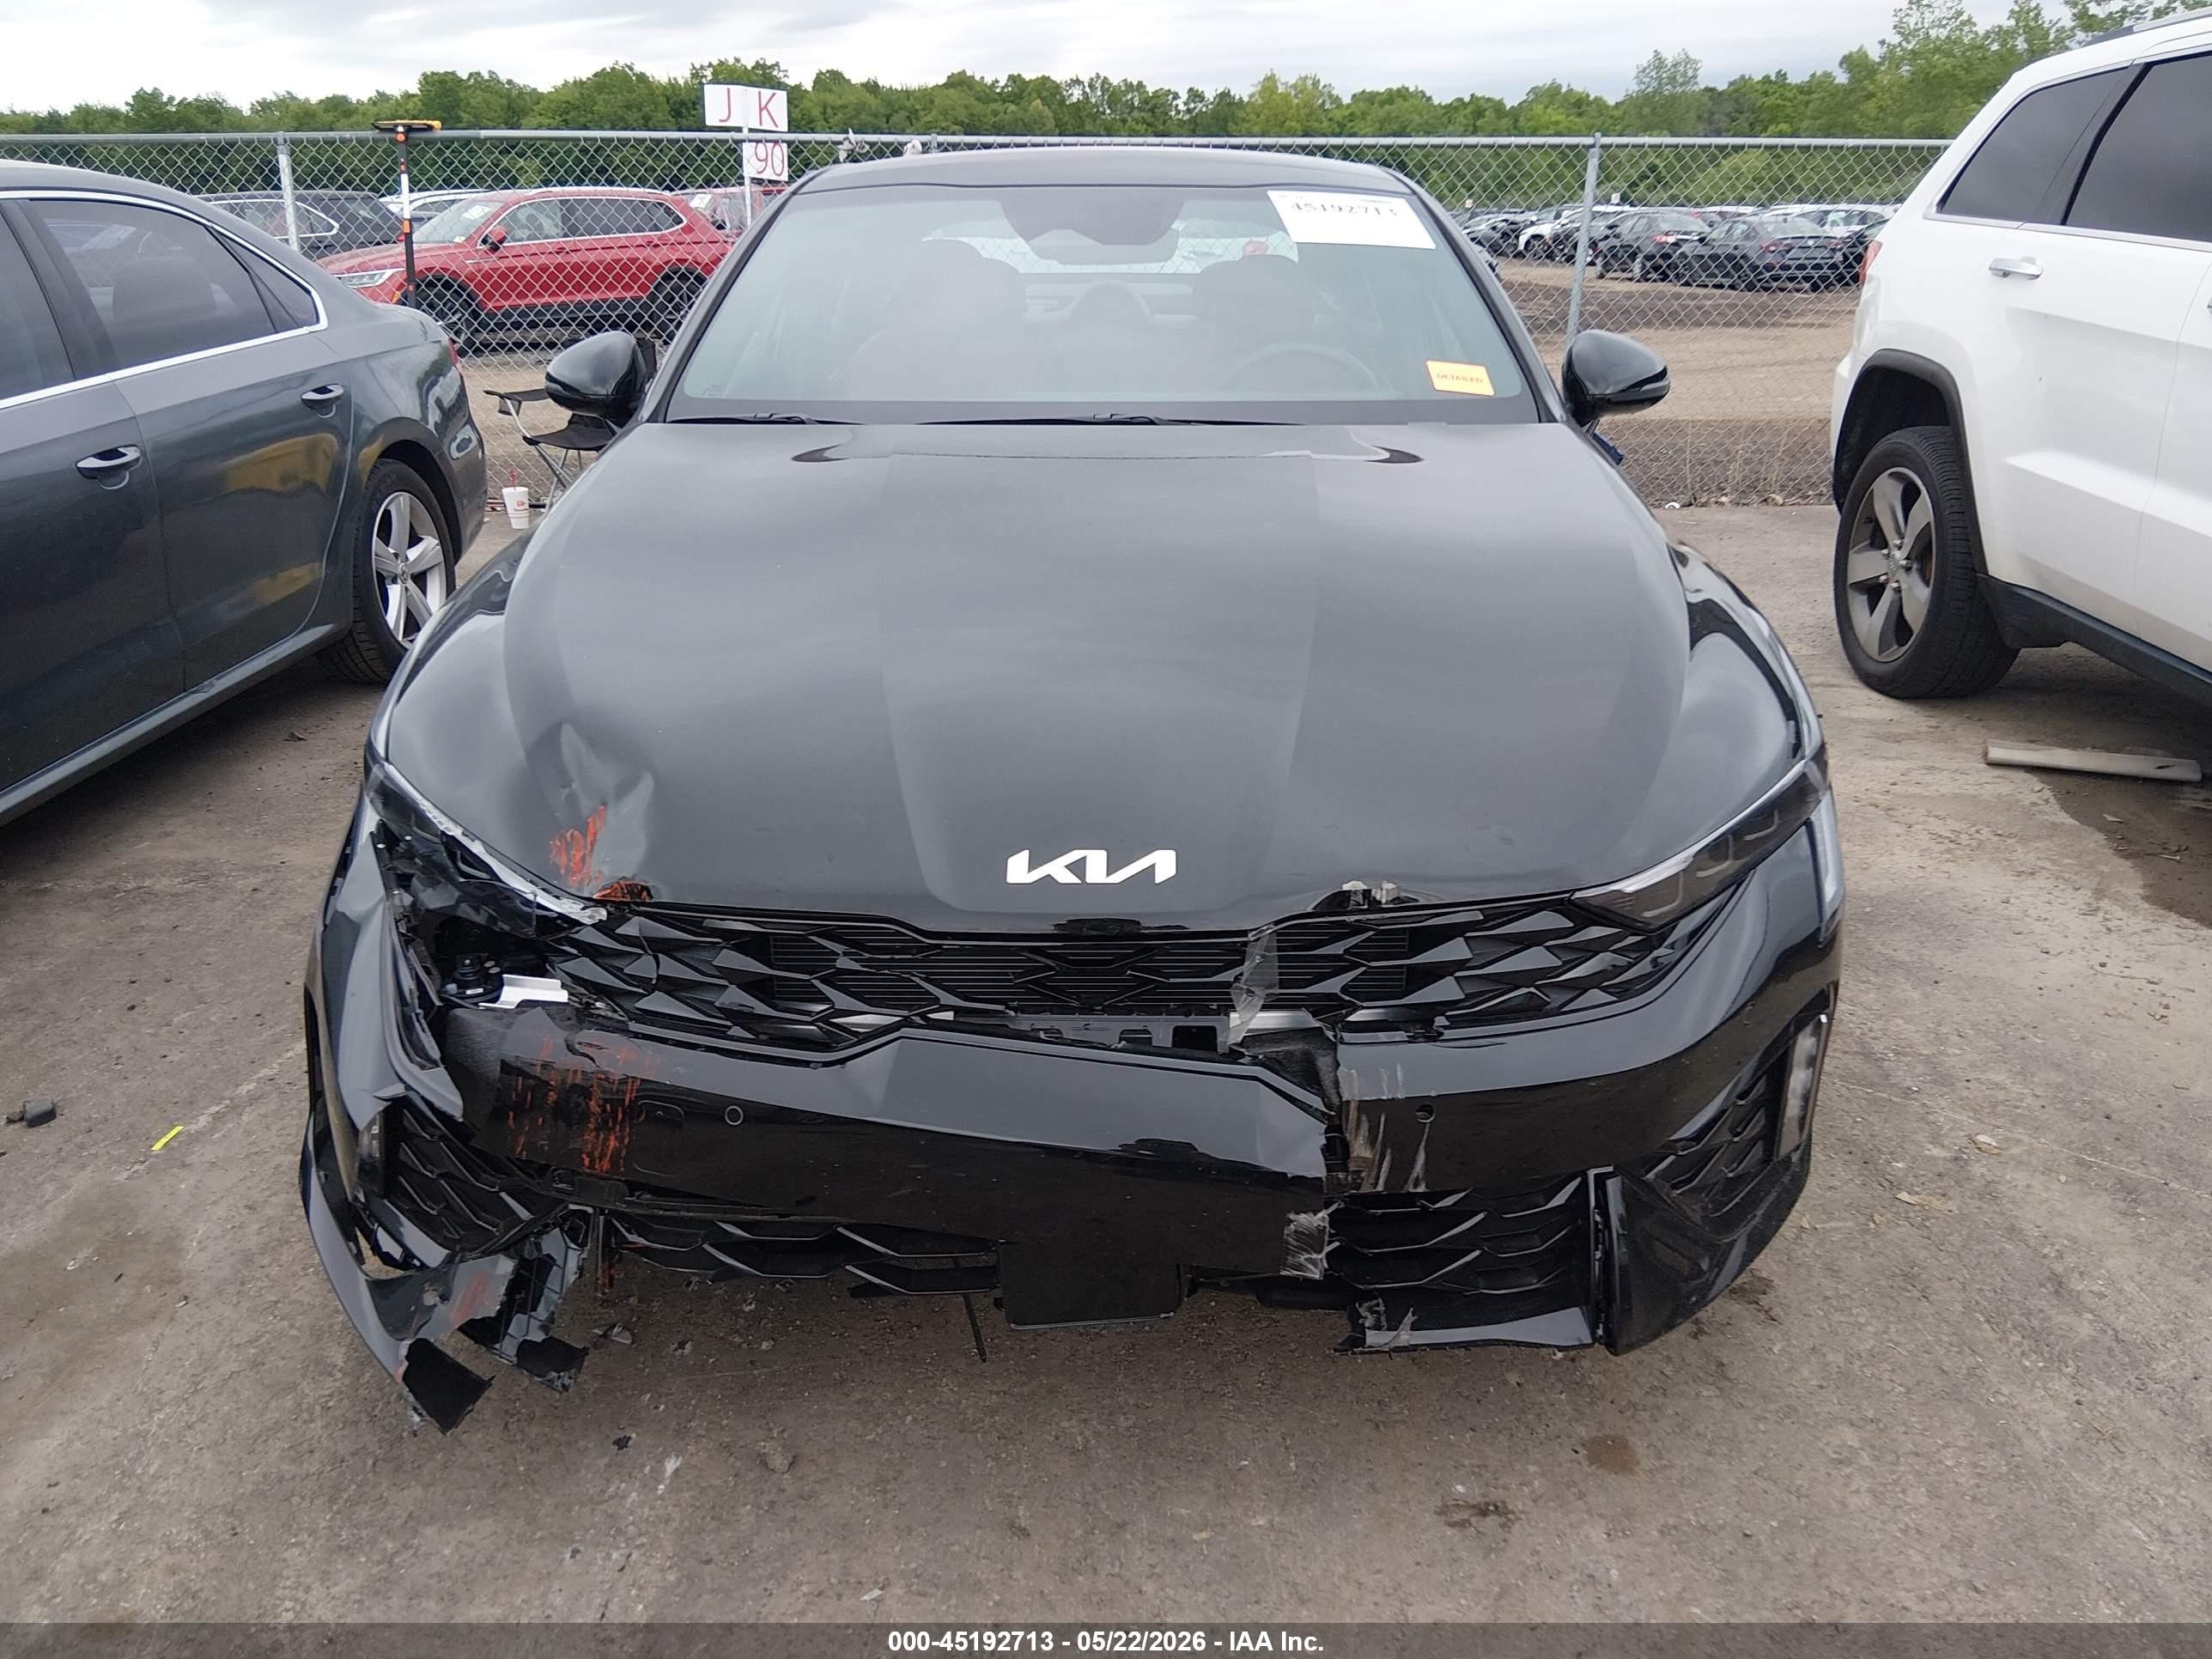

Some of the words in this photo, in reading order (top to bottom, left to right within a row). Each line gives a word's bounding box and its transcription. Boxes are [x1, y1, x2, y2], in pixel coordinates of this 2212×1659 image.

[719, 88, 731, 122] J
[758, 91, 778, 128] K
[755, 142, 785, 177] 90
[1006, 848, 1177, 885] KIA
